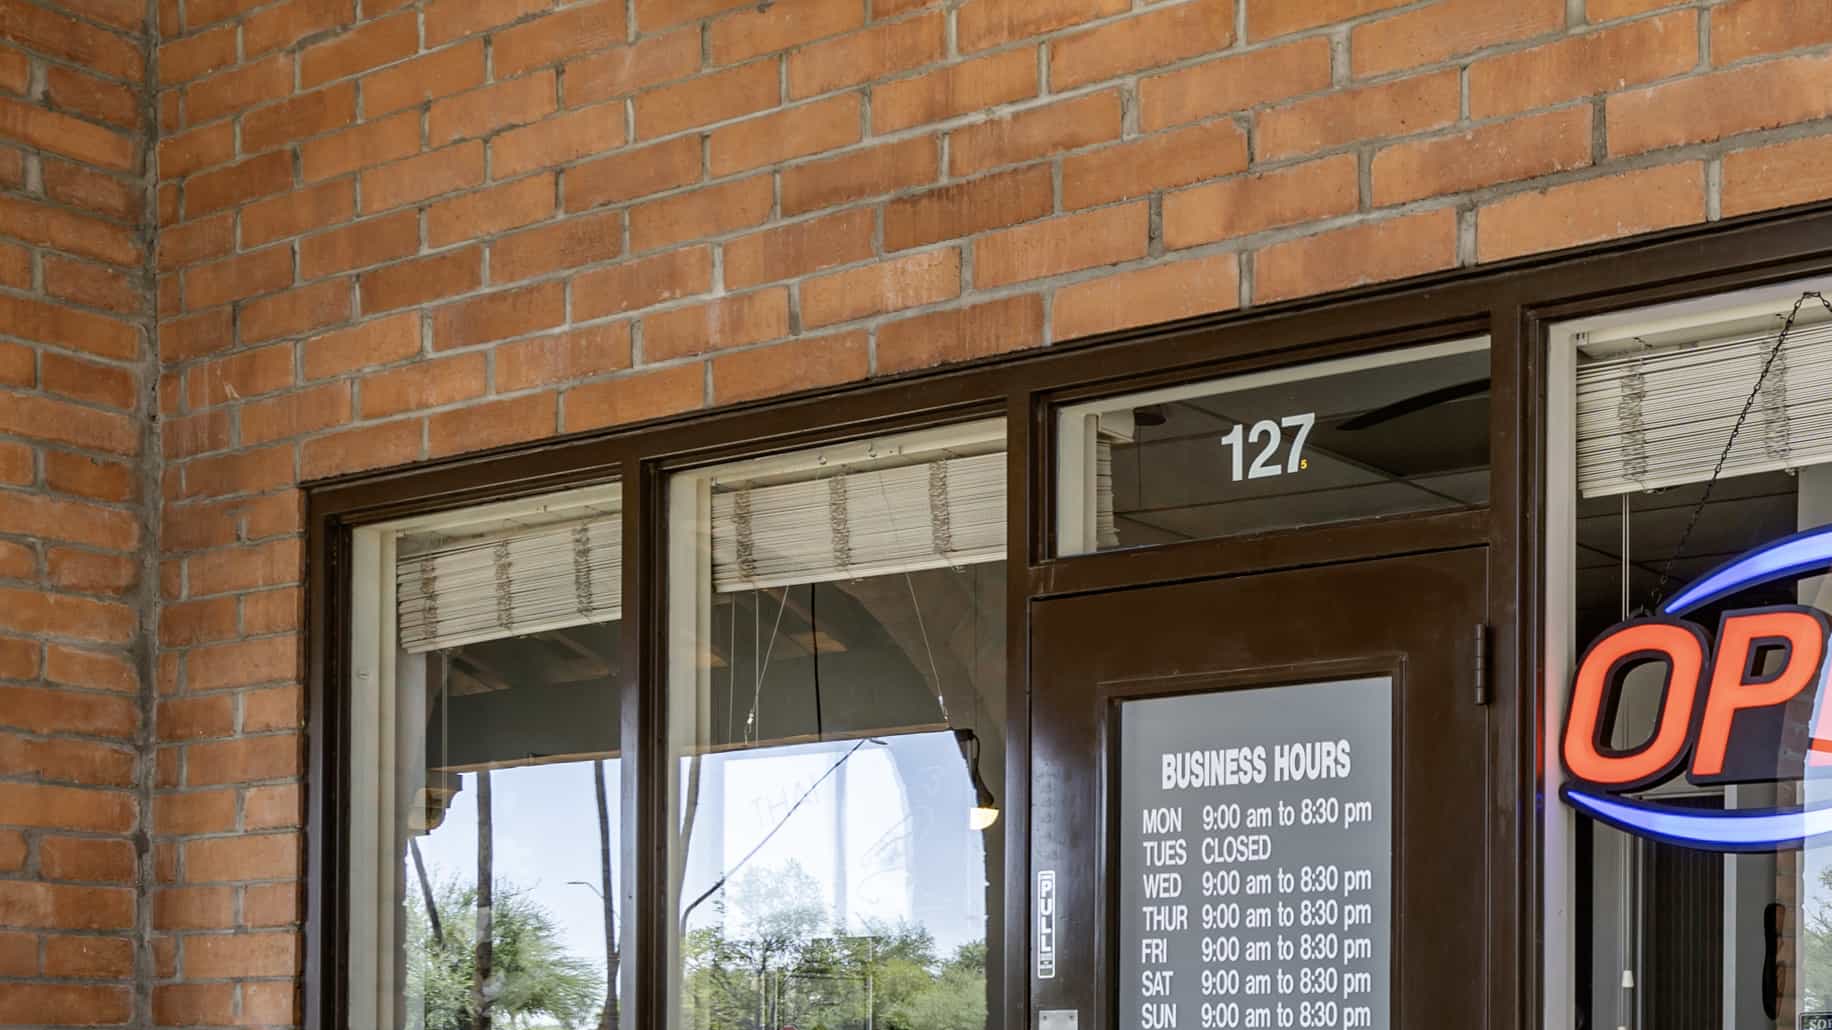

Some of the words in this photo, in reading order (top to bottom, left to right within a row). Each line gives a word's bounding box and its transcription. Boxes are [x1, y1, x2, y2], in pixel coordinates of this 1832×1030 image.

[1221, 412, 1315, 482] 127
[1162, 746, 1266, 789] BUSINESS
[1274, 739, 1350, 782] HOURS
[1143, 808, 1181, 834] MON
[1203, 804, 1240, 830] 9:00
[1246, 808, 1272, 828] am
[1278, 800, 1295, 826] to
[1301, 797, 1338, 824] 8:30
[1345, 801, 1371, 829] pm
[1143, 839, 1187, 866] TUES
[1202, 835, 1271, 864] CLOSED
[1143, 873, 1181, 899] WED
[1202, 870, 1240, 896] 9:00
[1246, 874, 1271, 894] am
[1278, 868, 1294, 893] to
[1301, 865, 1338, 892] 8:30
[1344, 870, 1371, 896] pm
[1040, 880, 1053, 953] PULL
[1142, 905, 1188, 931] THUR
[1202, 903, 1240, 929] 9:00
[1246, 908, 1271, 928] am
[1277, 901, 1294, 926] to
[1300, 899, 1338, 926] 8:30
[1344, 904, 1371, 931] pm
[1142, 938, 1167, 964] FRI
[1202, 936, 1239, 962] 9:00
[1245, 941, 1271, 961] am
[1277, 935, 1294, 960] to
[1300, 933, 1338, 960] 8:30
[1344, 938, 1371, 965] pm
[1142, 970, 1174, 997] SAT
[1201, 970, 1239, 995] 9:00
[1245, 974, 1271, 994] am
[1277, 968, 1293, 994] to
[1300, 968, 1337, 993] 8:30
[1344, 973, 1371, 999] pm
[1141, 1003, 1176, 1029] SUN
[1201, 1003, 1239, 1028] 9:00
[1245, 1008, 1270, 1028] am
[1277, 1002, 1293, 1027] to
[1300, 1001, 1337, 1027] 8:30
